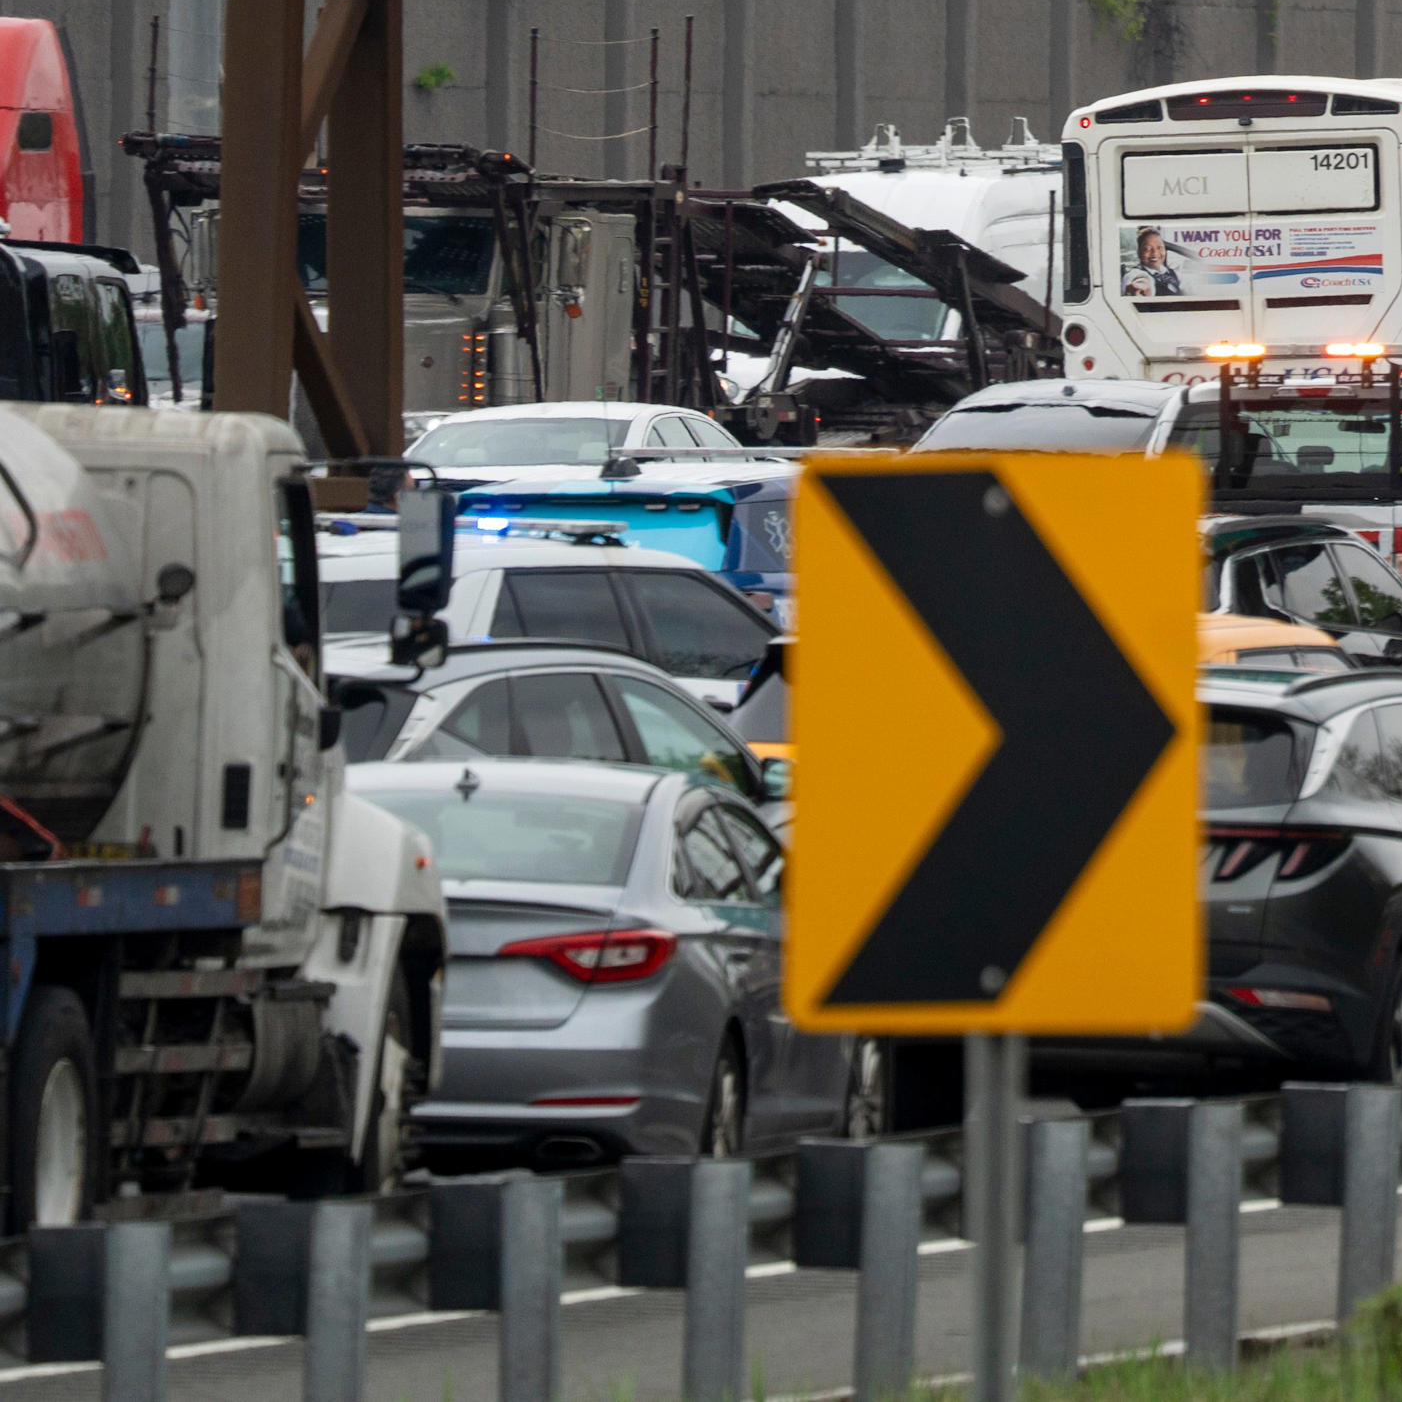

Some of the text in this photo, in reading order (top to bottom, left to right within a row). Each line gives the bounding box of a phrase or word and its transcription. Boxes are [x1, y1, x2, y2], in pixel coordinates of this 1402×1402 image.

[1309, 151, 1370, 171] 14201
[1161, 176, 1209, 196] MCI
[1173, 228, 1282, 243] I WANT YOU FOR
[1198, 245, 1244, 259] Coach
[1321, 278, 1351, 287] Coach
